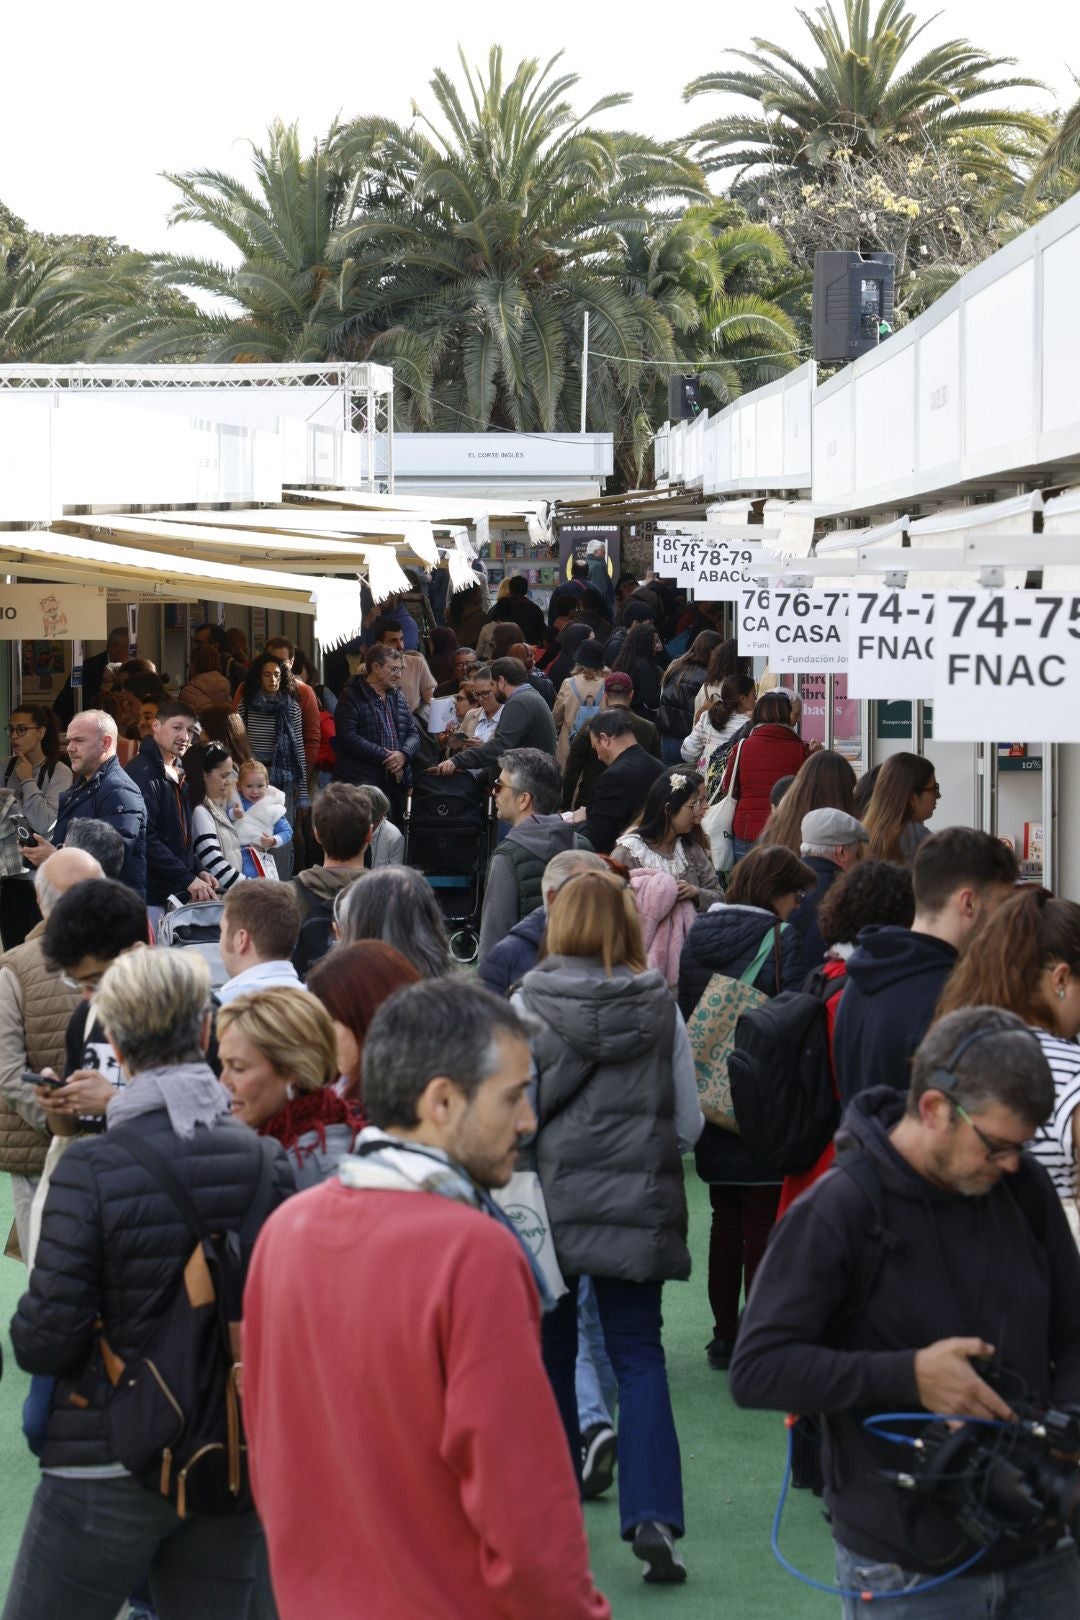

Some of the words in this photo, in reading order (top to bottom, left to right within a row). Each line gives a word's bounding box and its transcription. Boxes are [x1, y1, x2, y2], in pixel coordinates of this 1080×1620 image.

[698, 550, 752, 566] 78-79
[698, 570, 759, 584] ABACU
[775, 624, 841, 643] CASA
[787, 655, 835, 664] Fundación
[948, 653, 1066, 687] FNAC
[1021, 759, 1041, 769] 10%
